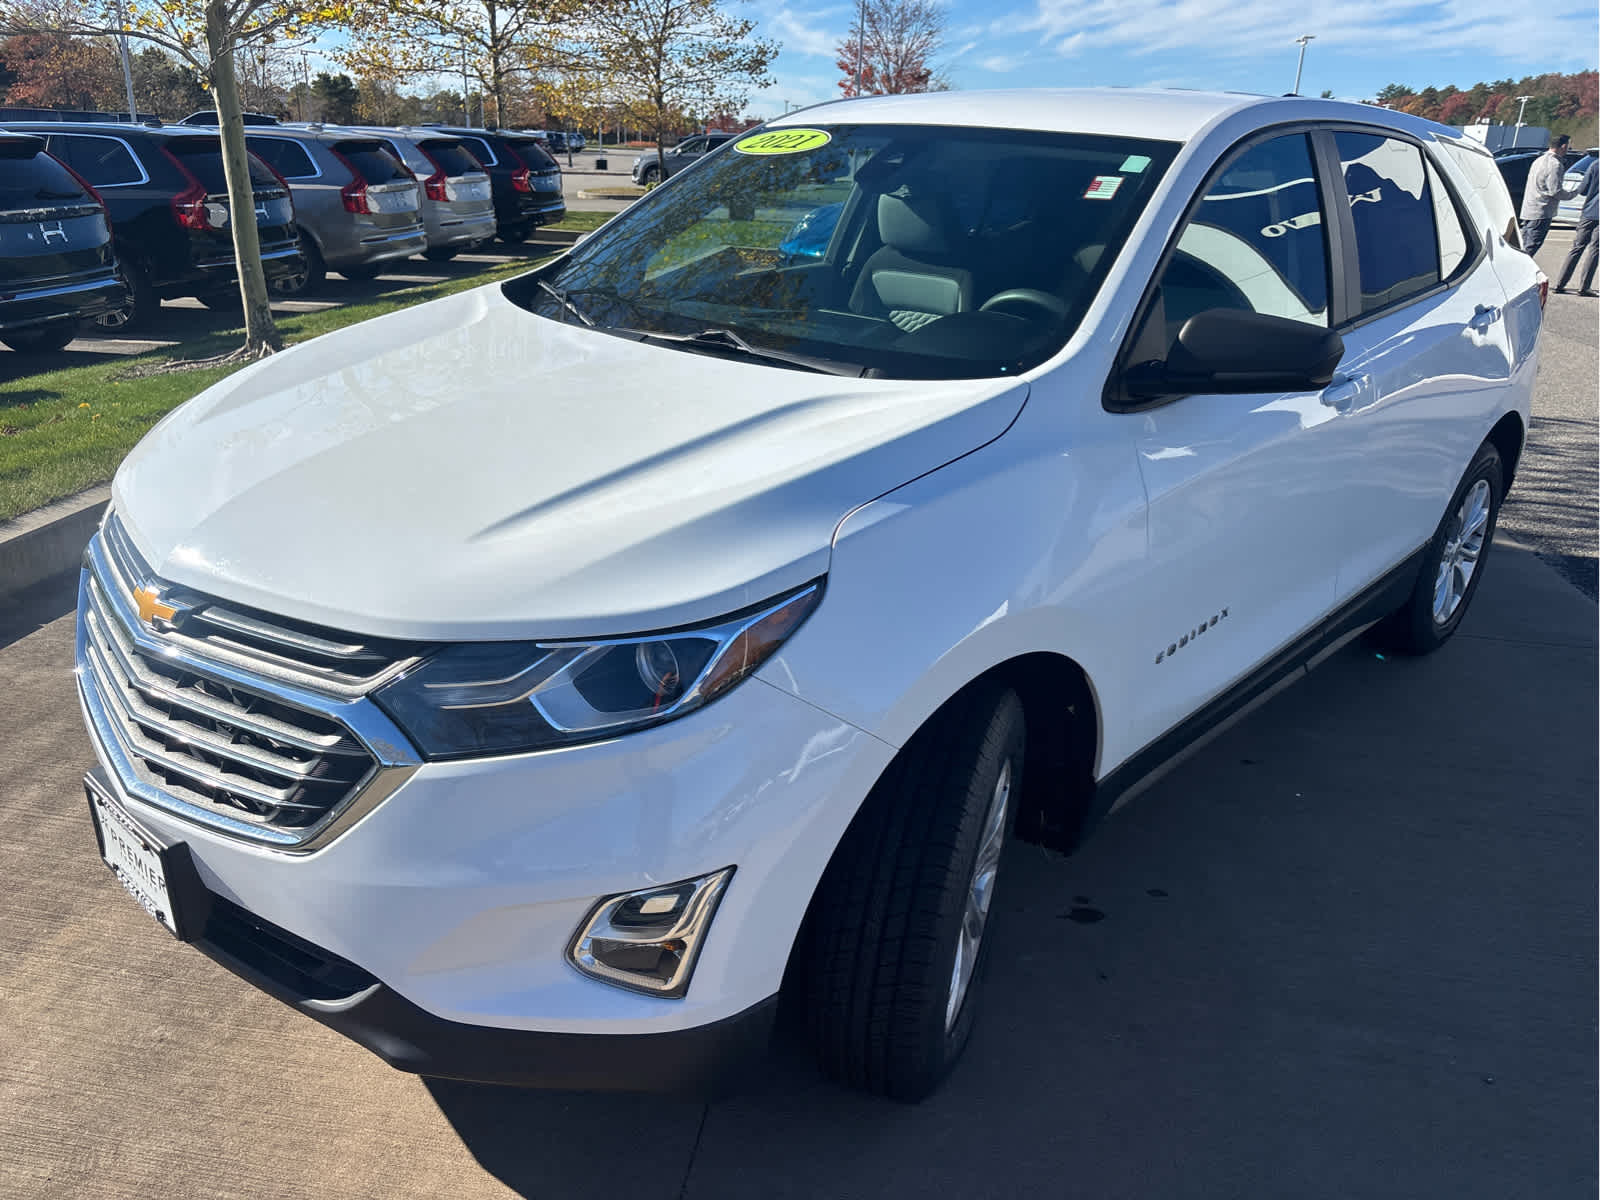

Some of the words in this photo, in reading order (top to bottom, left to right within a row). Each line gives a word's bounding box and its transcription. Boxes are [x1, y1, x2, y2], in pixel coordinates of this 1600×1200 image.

[744, 134, 820, 149] 2021
[1155, 607, 1229, 664] EQUINOX
[111, 827, 167, 891] PREMIER
